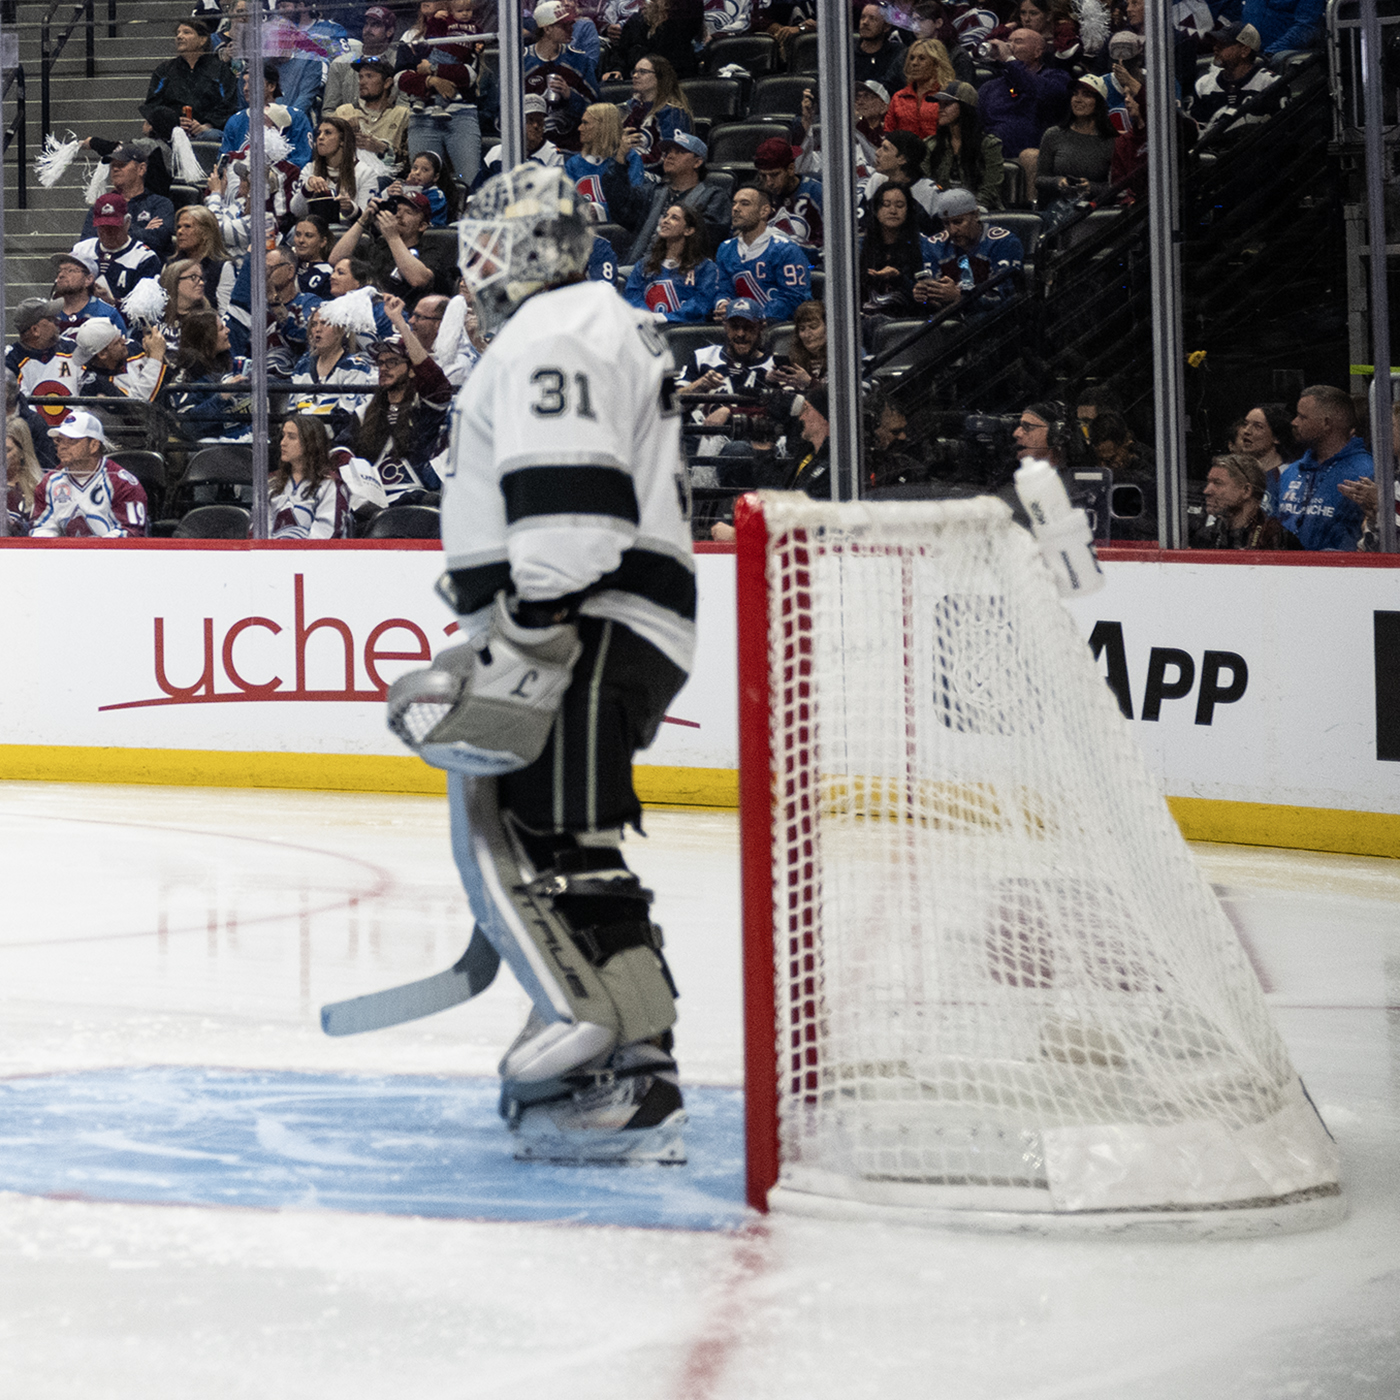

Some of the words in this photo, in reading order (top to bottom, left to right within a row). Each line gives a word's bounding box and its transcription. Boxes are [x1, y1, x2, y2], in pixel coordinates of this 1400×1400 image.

[602, 261, 613, 279] 8
[685, 269, 696, 285] A
[755, 261, 766, 277] C
[784, 264, 807, 286] 92
[117, 271, 127, 288] A
[308, 274, 320, 289] C
[59, 361, 71, 378] A
[530, 367, 598, 420] 31
[90, 487, 103, 505] C
[126, 502, 144, 526] 19
[153, 573, 432, 695] uche
